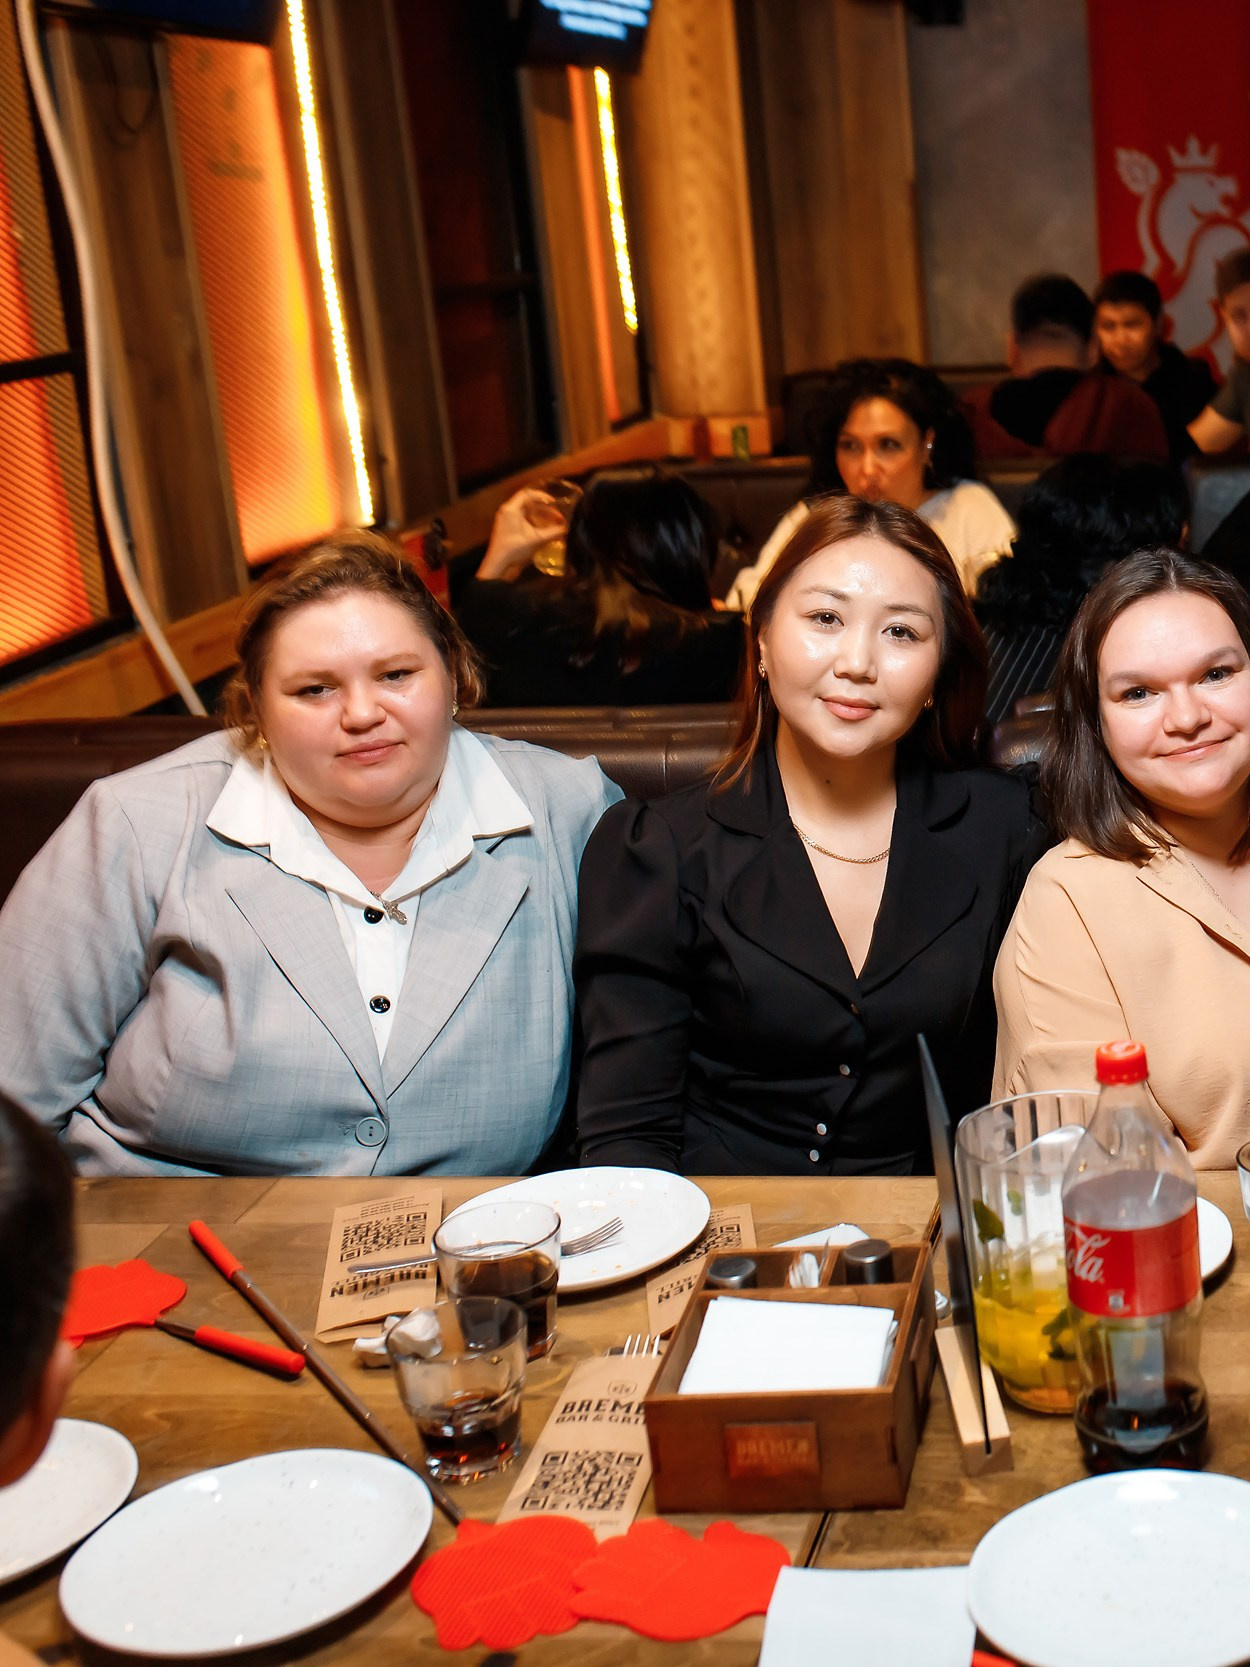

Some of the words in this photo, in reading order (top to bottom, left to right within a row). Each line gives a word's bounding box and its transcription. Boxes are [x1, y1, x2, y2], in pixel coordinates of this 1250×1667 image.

[1065, 1223, 1111, 1283] ola
[330, 1270, 428, 1298] BREMEN
[561, 1400, 645, 1414] BREME
